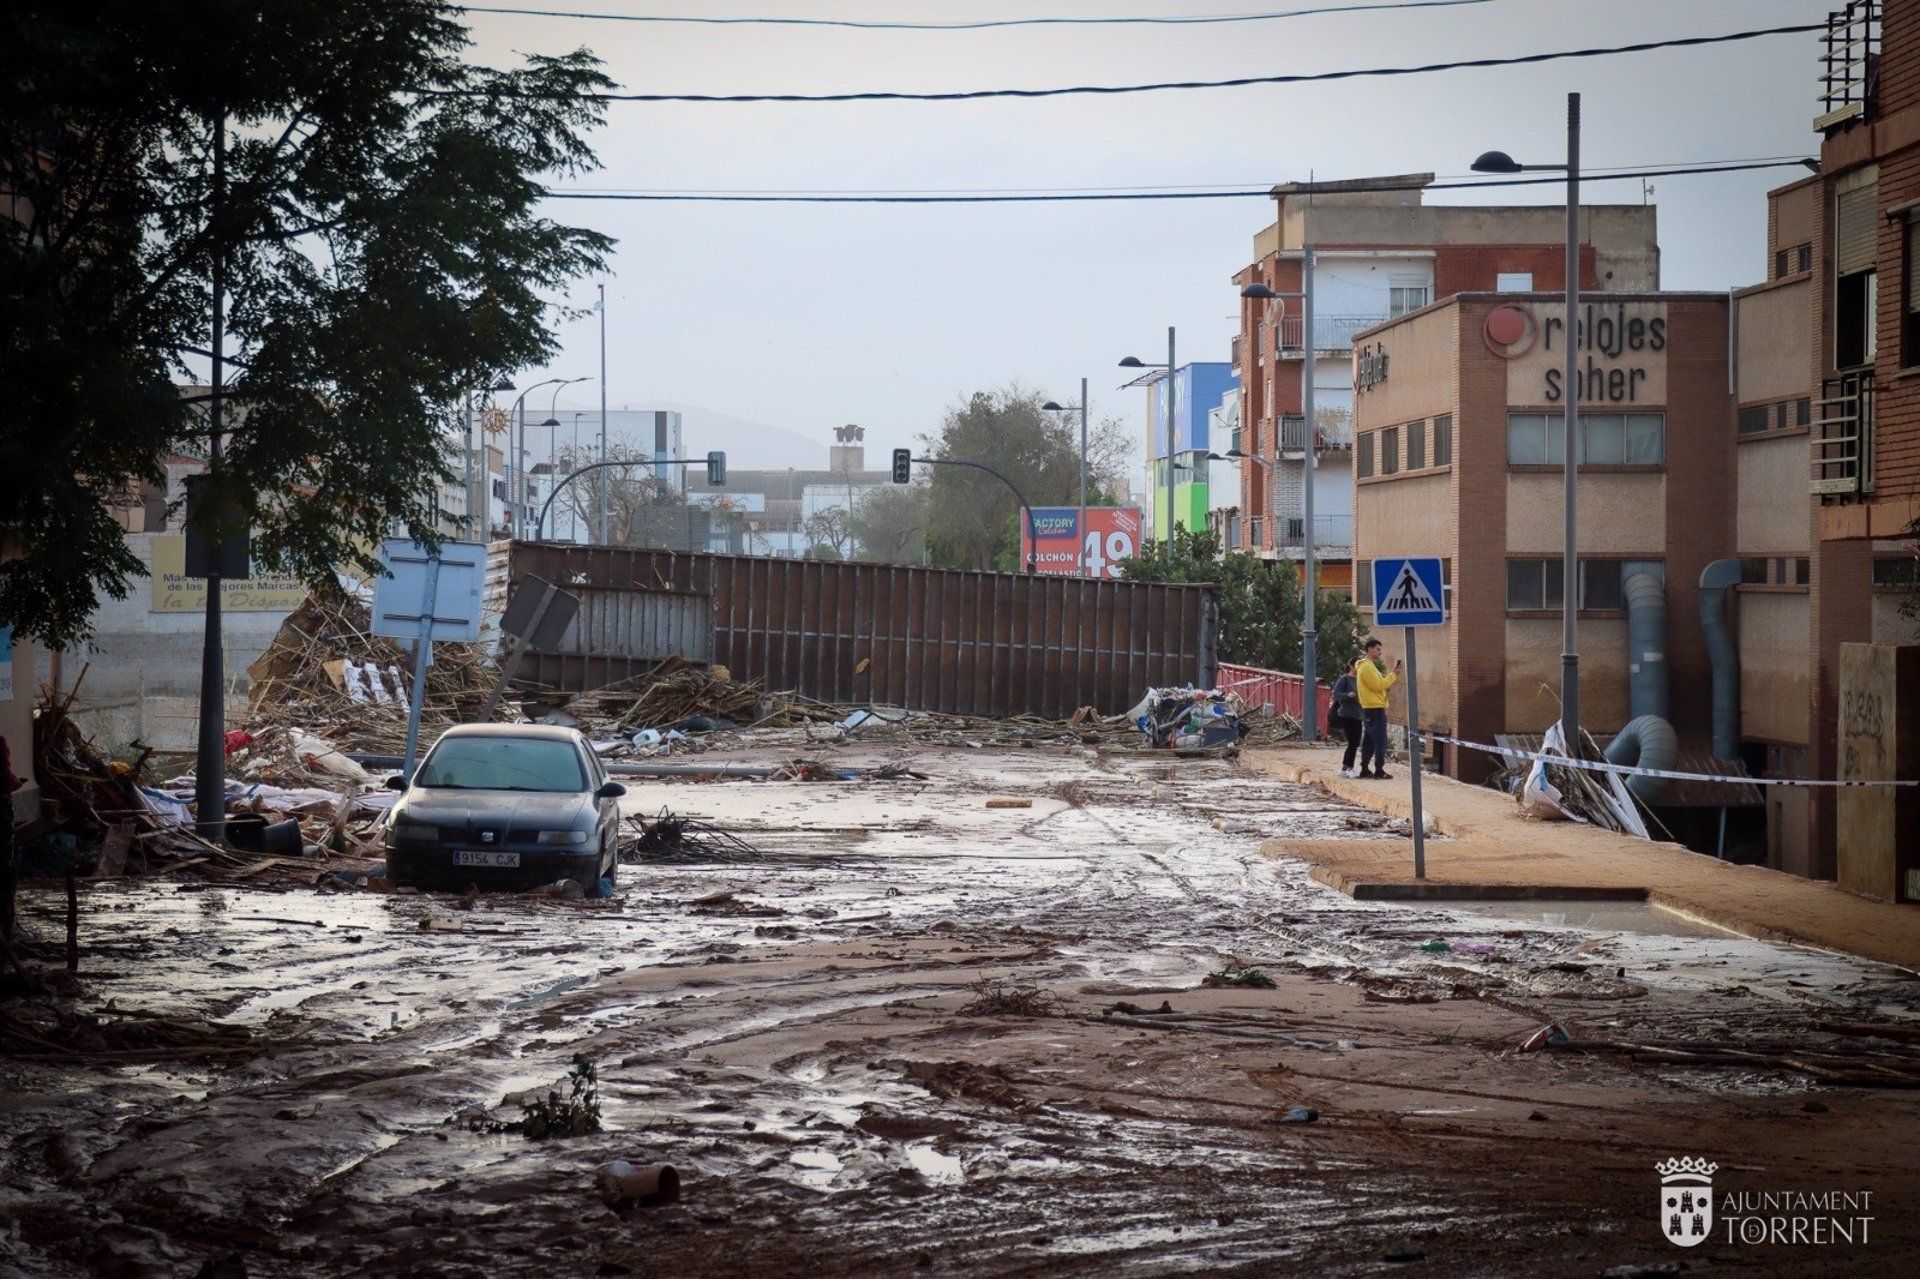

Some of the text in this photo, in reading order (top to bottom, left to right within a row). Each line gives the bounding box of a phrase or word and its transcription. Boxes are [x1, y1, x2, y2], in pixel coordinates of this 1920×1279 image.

[1545, 304, 1665, 359] rlojes
[1545, 355, 1646, 402] sher
[1077, 531, 1134, 577] 49
[168, 583, 182, 591] de
[186, 582, 202, 591] las
[257, 582, 299, 590] Marcas
[461, 852, 488, 865] 9154
